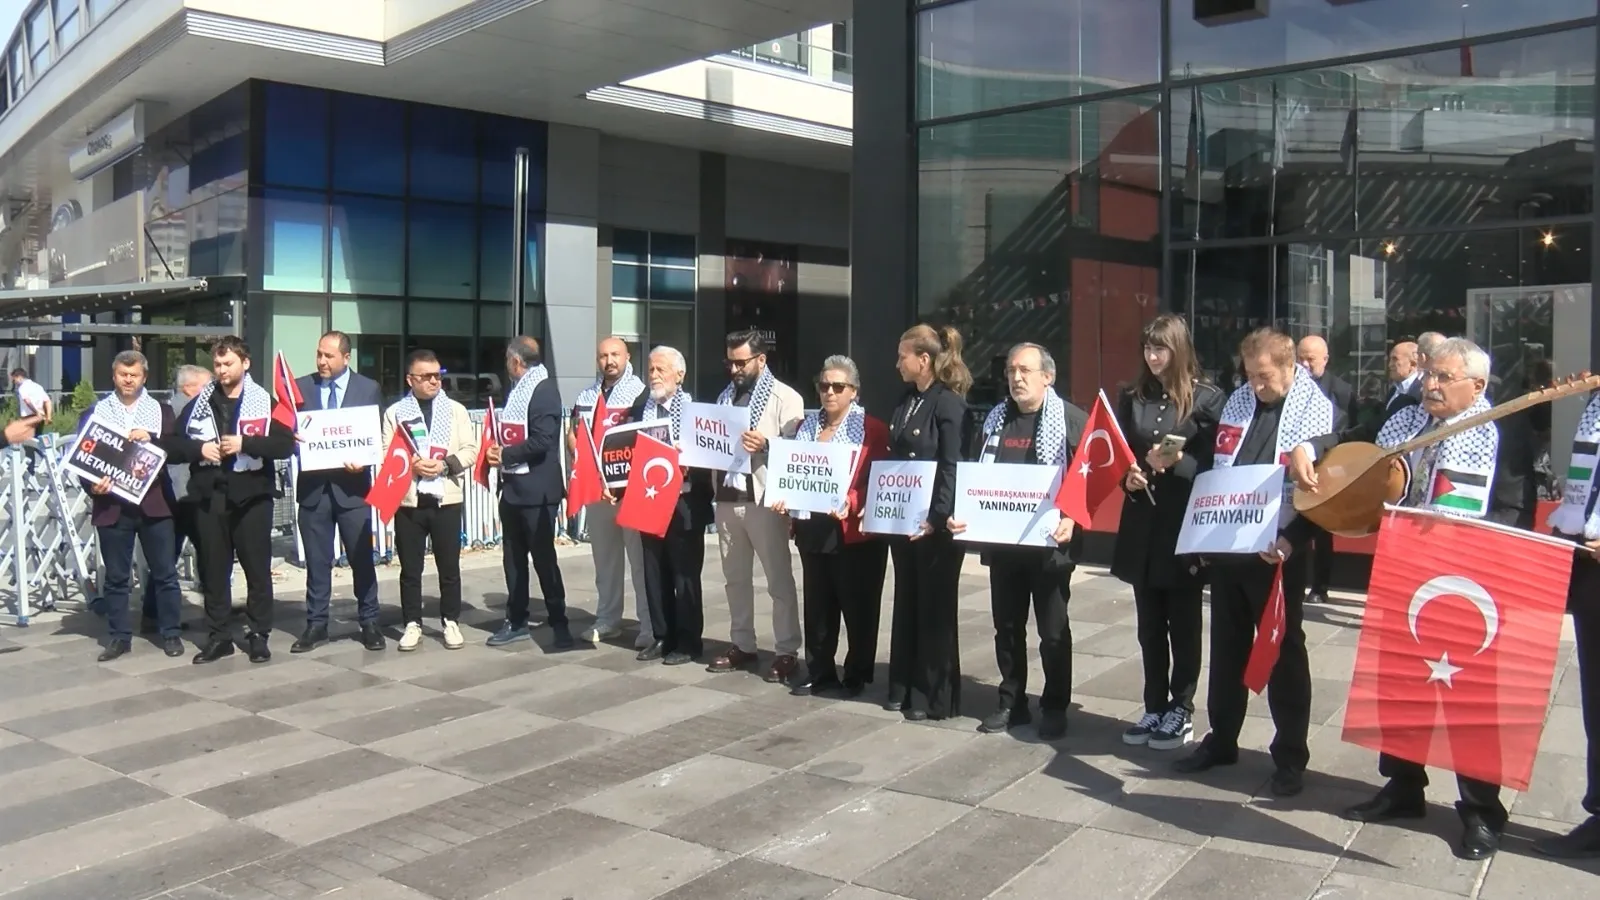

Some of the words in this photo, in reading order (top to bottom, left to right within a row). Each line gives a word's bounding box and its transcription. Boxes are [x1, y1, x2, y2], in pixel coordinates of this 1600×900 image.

[322, 425, 353, 436] FREE
[695, 416, 730, 438] KATİL
[308, 437, 374, 451] PALESTINE
[695, 435, 734, 456] İSRAİL
[791, 452, 829, 465] DÜNYA
[76, 450, 143, 490] NETANYAHU
[787, 463, 833, 477] BEŞTEN
[778, 477, 839, 494] BÜYÜKTÜR
[878, 474, 923, 489] ÇOCUK
[875, 490, 912, 504] KATİLİ
[967, 488, 1051, 500] CUMHURBAŞKANIMIZIN
[1193, 494, 1227, 509] BEBEK
[1229, 490, 1268, 506] KATİLİ
[874, 504, 906, 520] İSRAİL
[979, 500, 1037, 513] YANINDAYIZ
[1191, 509, 1264, 526] NETANYAHU
